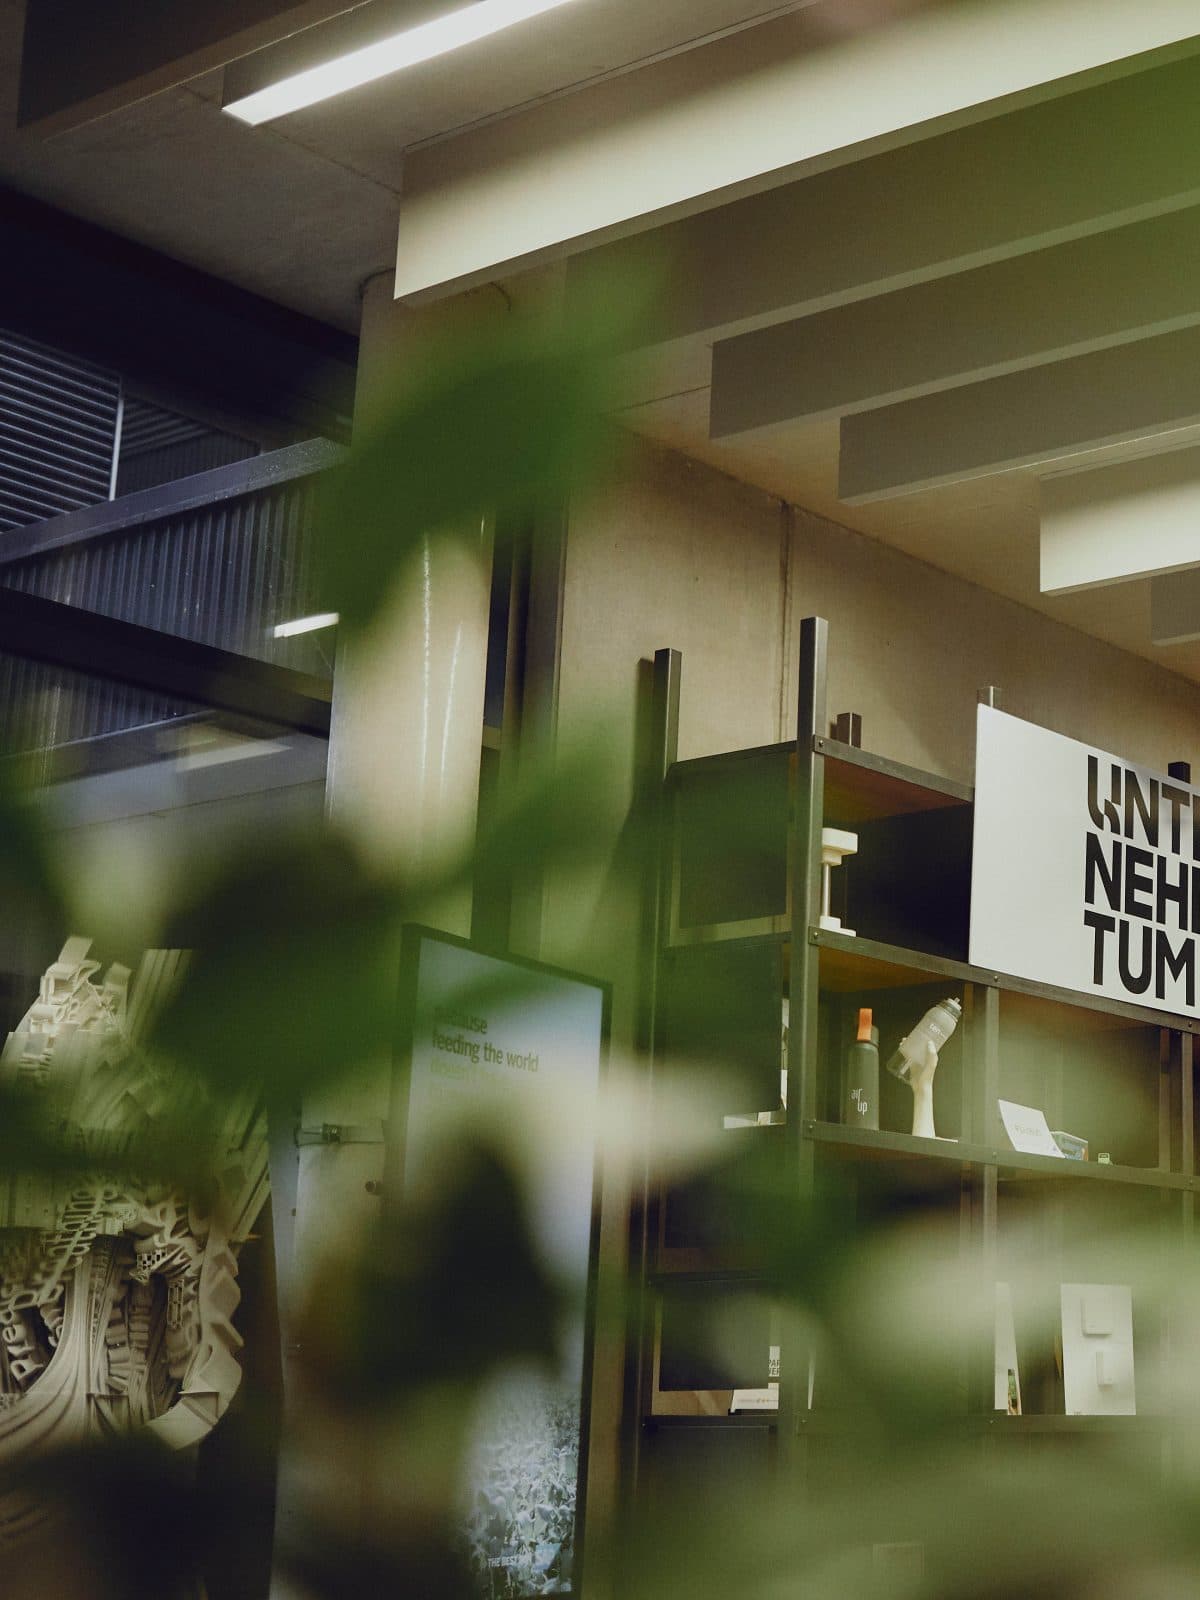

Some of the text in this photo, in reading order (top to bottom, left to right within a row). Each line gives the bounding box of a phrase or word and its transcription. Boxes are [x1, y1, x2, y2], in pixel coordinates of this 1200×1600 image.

[1084, 909, 1195, 1007] TUM
[431, 1025, 482, 1065] feeding
[483, 1041, 504, 1065] the
[506, 1052, 539, 1073] world
